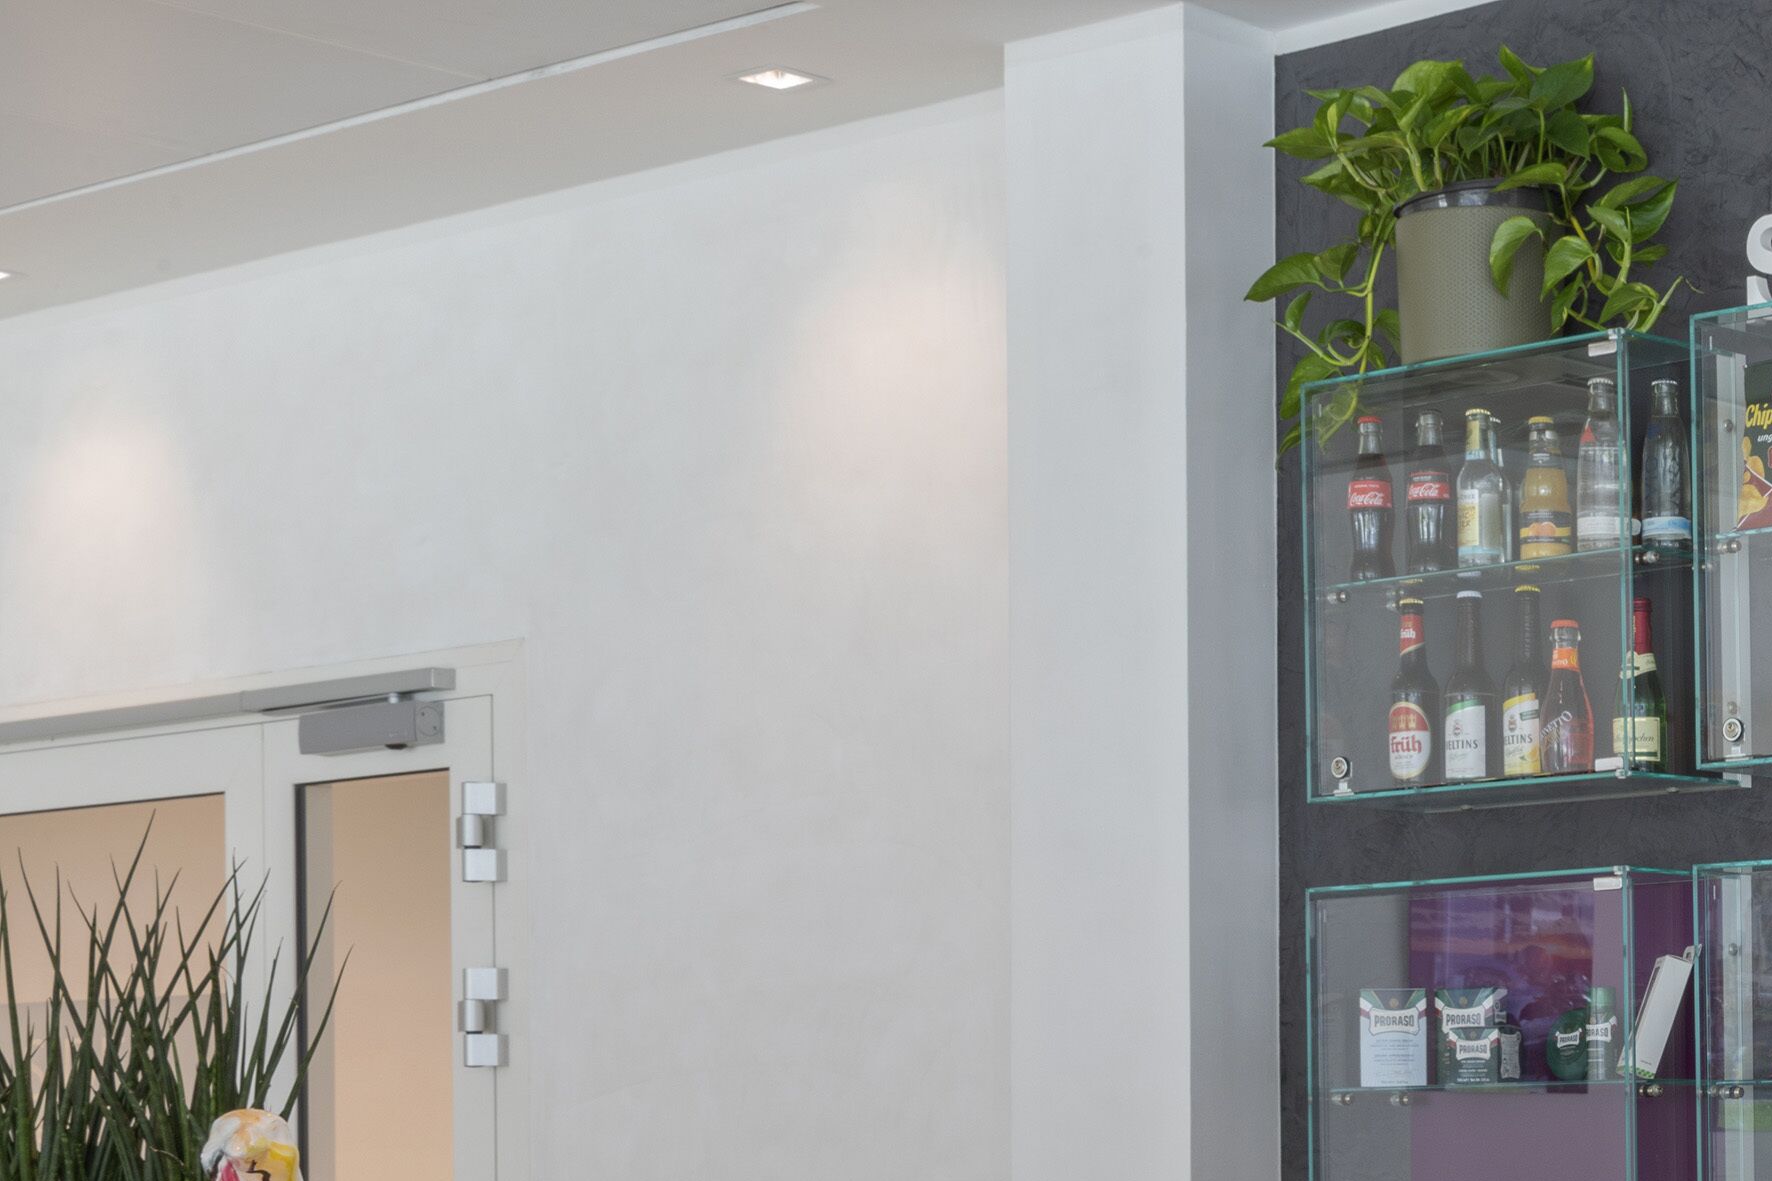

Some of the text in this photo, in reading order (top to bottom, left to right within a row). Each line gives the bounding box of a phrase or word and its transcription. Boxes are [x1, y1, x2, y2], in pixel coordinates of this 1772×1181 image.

[1391, 735, 1422, 753] früh
[1447, 739, 1479, 750] ELTINS
[1504, 733, 1533, 745] ELTINS
[1374, 1015, 1415, 1027] PRORASO
[1446, 1013, 1482, 1026] PRORASO
[1458, 1044, 1487, 1055] PRORASO
